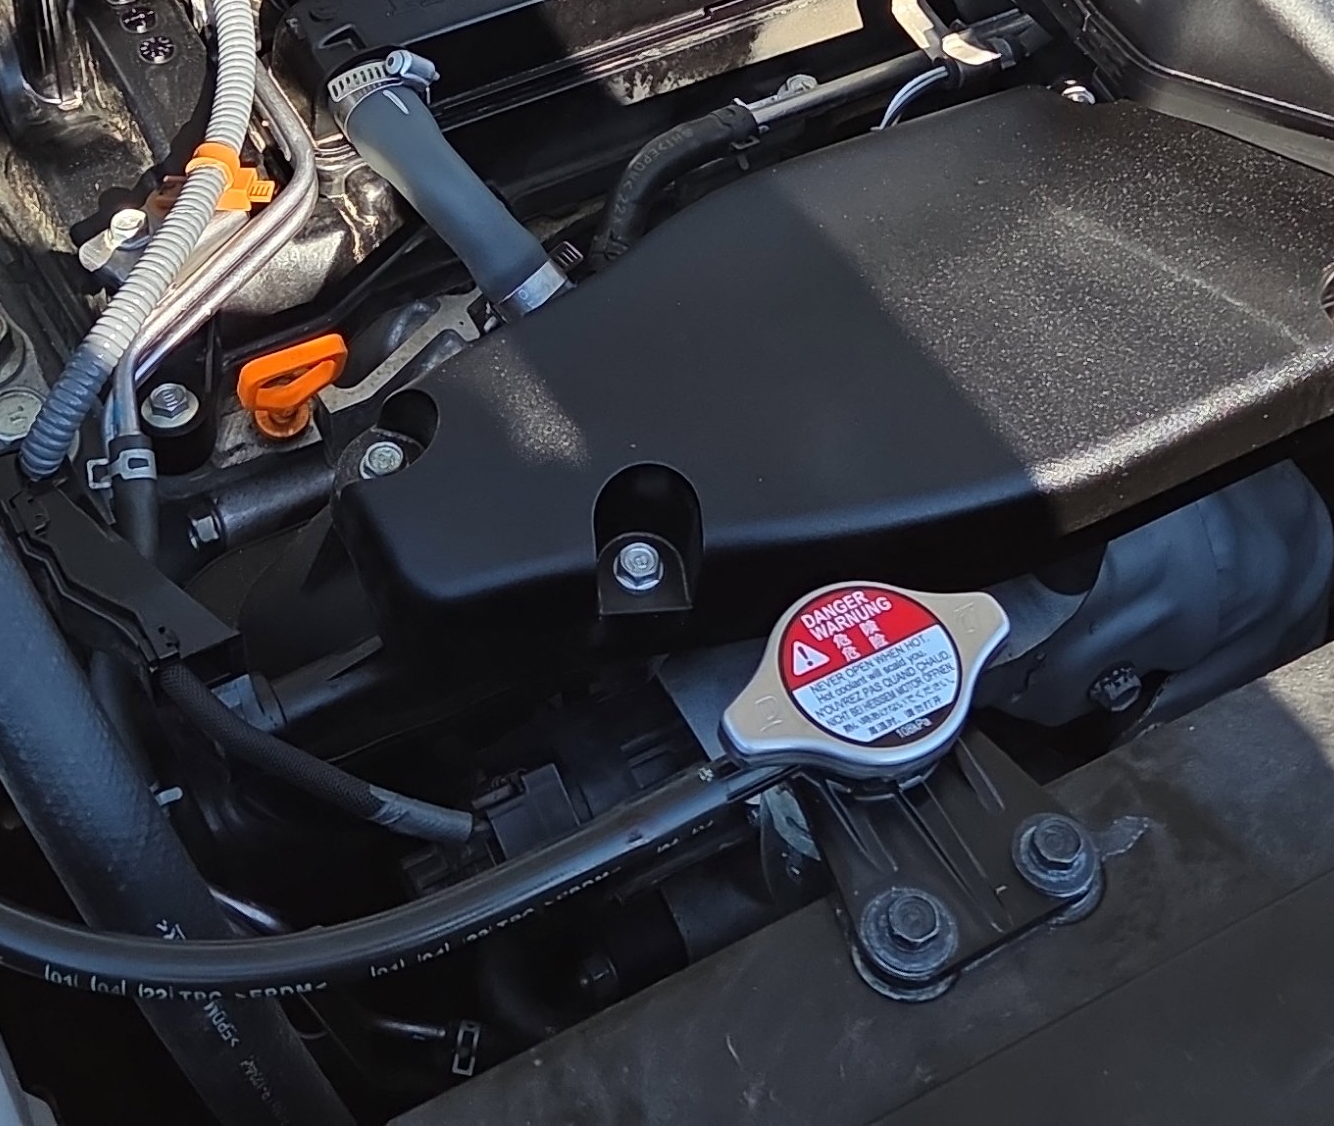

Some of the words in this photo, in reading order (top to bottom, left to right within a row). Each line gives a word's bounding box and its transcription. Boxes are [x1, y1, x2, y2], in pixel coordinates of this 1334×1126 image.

[801, 590, 869, 630] DANGER
[810, 596, 893, 642] WARNUNG
[809, 672, 846, 695] NEVER
[844, 658, 874, 678] OPEN
[873, 644, 905, 665] WHEN
[903, 632, 930, 651] HOT.
[816, 688, 835, 704] Hot
[833, 674, 867, 696] coolant
[866, 667, 882, 681] will
[881, 656, 906, 674] scald
[906, 648, 928, 665] you.
[862, 681, 883, 698] PAS
[881, 666, 917, 689] QUAND
